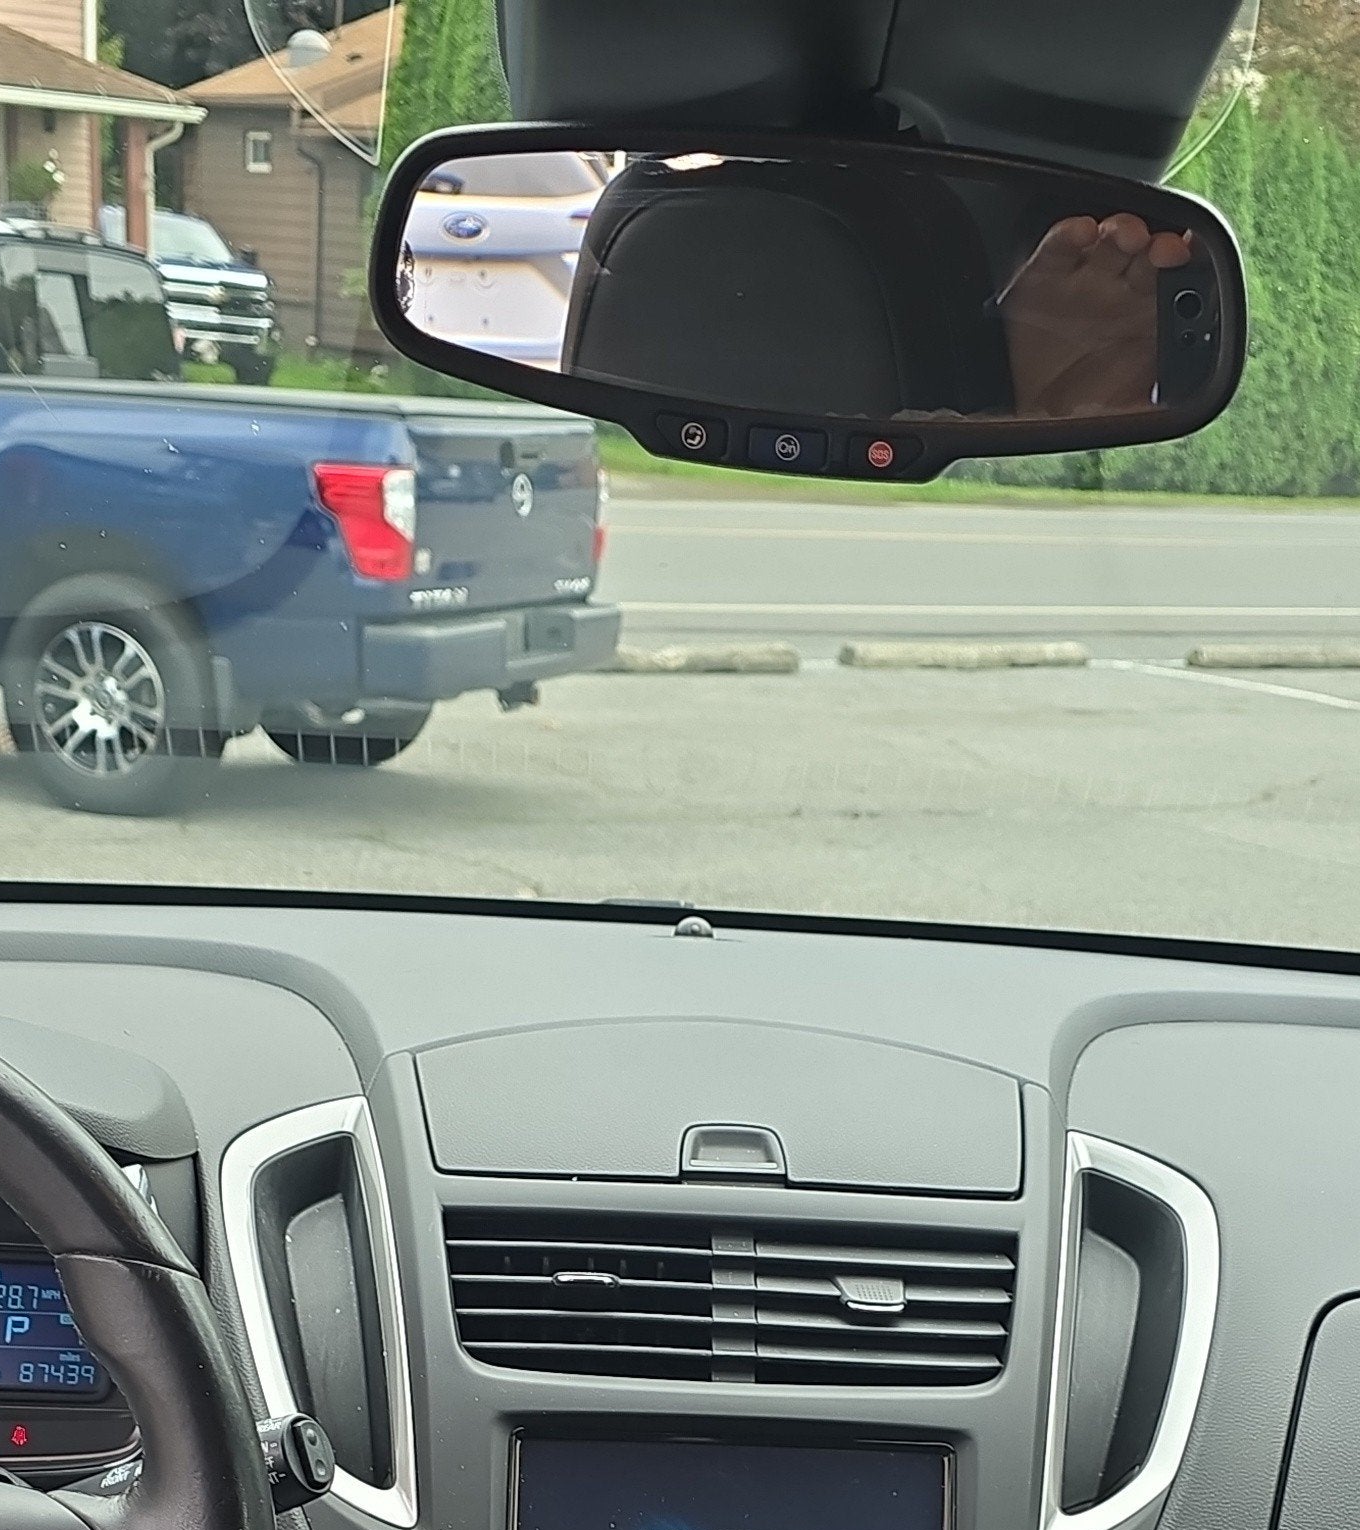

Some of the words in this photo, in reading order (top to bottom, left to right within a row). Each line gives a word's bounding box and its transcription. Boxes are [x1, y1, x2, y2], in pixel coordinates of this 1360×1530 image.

[870, 449, 891, 460] SOS
[5, 1316, 29, 1343] P
[19, 1363, 94, 1384] 87439
